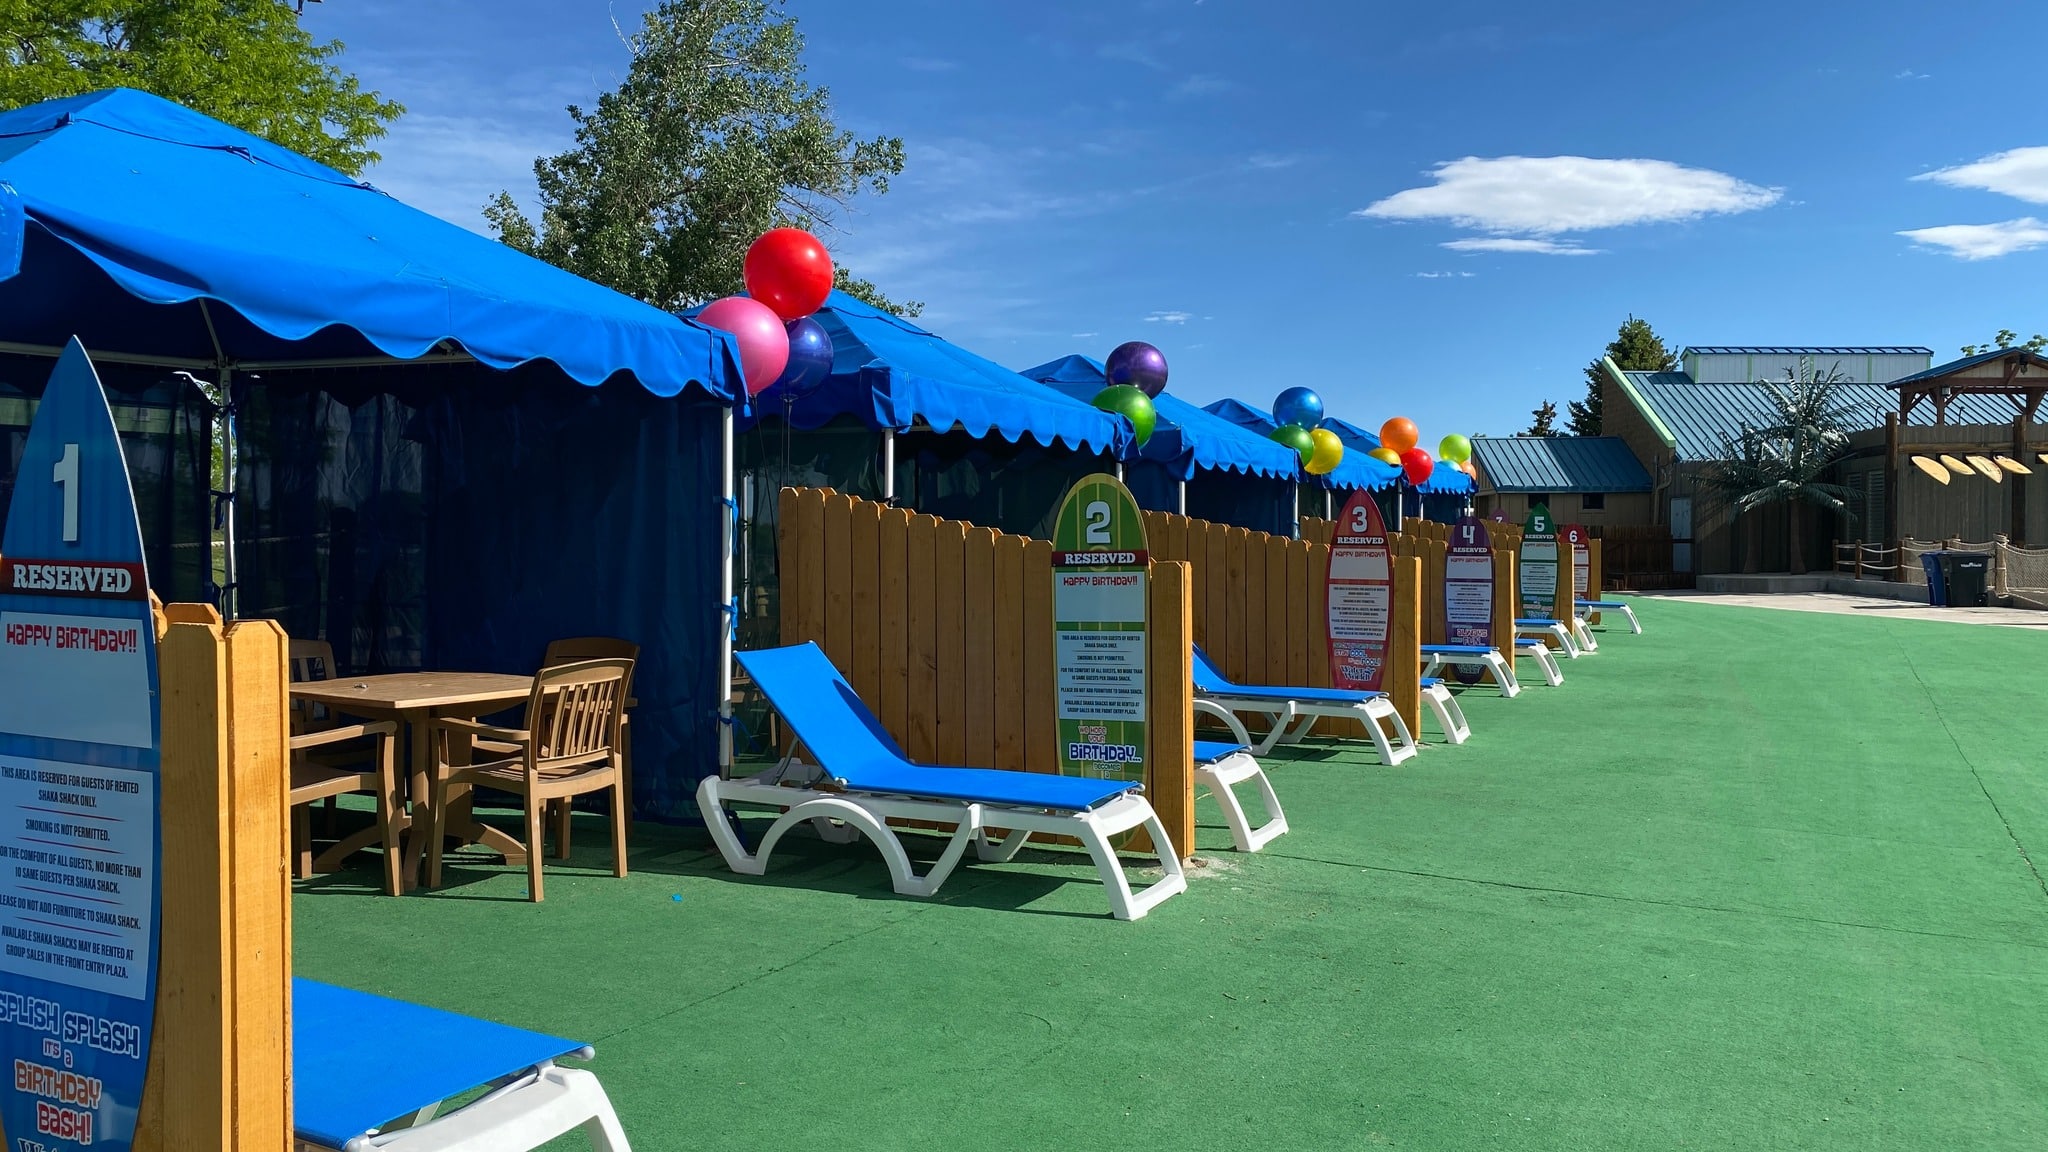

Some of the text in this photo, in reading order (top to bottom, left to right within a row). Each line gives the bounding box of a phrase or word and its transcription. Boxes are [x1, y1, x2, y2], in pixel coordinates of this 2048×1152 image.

[53, 444, 79, 542] 1
[1086, 501, 1110, 544] 2
[1352, 506, 1367, 532] 3
[1534, 516, 1544, 532] 5
[1338, 536, 1384, 544] RESERVED
[1462, 526, 1475, 544] 4
[1570, 530, 1578, 542] 6
[1065, 552, 1136, 564] RESERVED
[13, 564, 132, 593] RESERVED
[1, 766, 139, 794] THIS AREA IS RESERVED FOR GUESTS OF RENTED
[38, 790, 97, 808] SHAKA SHACK ONLY.
[26, 818, 110, 841] SMOKING IS NOT PERMITTED.
[9, 847, 19, 859] THE
[20, 849, 48, 862] COMFORT
[49, 853, 57, 864] OF
[58, 854, 68, 866] ALL
[70, 856, 94, 872] GUESTS,
[96, 861, 104, 872] NO
[106, 862, 124, 875] MORE
[125, 864, 142, 878] THAN
[16, 866, 120, 894] 10 SAME GUESTS PER SHAKA SHACK.
[18, 898, 26, 909] DO
[27, 899, 38, 910] NOT
[40, 901, 52, 913] ADD
[53, 904, 86, 920] FURNITURE
[87, 910, 94, 921] TO
[96, 911, 116, 925] SHAKA
[118, 915, 141, 930] SHACK.
[2, 925, 134, 960] AVAILABLE SHAKA SHACKS MAY BE RENTED AT
[6, 944, 128, 979] GROUP SALES IN THE FRONT ENTRY PLAZA.
